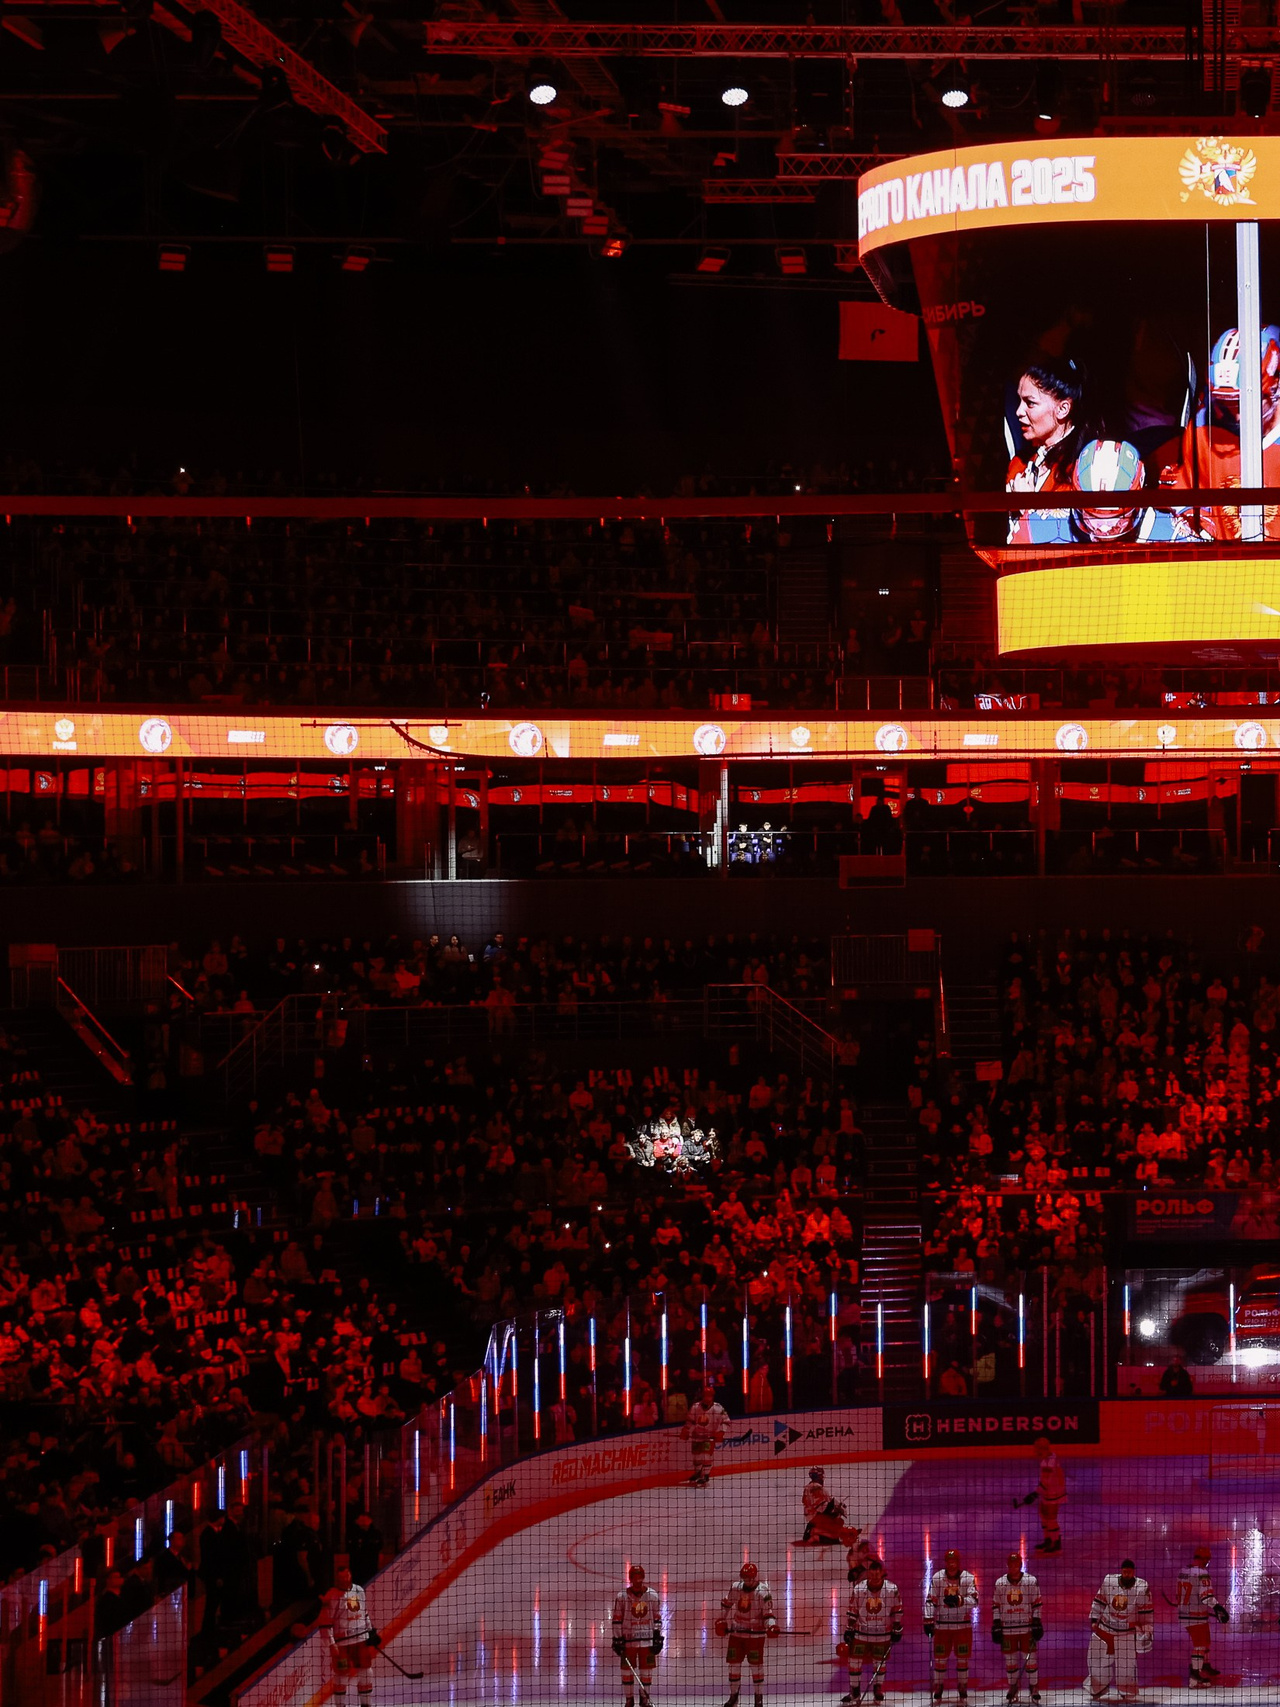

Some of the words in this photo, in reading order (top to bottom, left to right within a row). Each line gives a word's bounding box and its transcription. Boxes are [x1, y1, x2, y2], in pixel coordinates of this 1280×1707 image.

[906, 161, 1009, 221] КАНАЛА
[1011, 155, 1096, 207] 2025
[1135, 1198, 1215, 1216] РОЛЬФ
[806, 1426, 855, 1440] АРЕНА
[937, 1415, 1078, 1434] HENDERSON
[552, 1458, 579, 1487] RED
[579, 1444, 649, 1479] MACHINE
